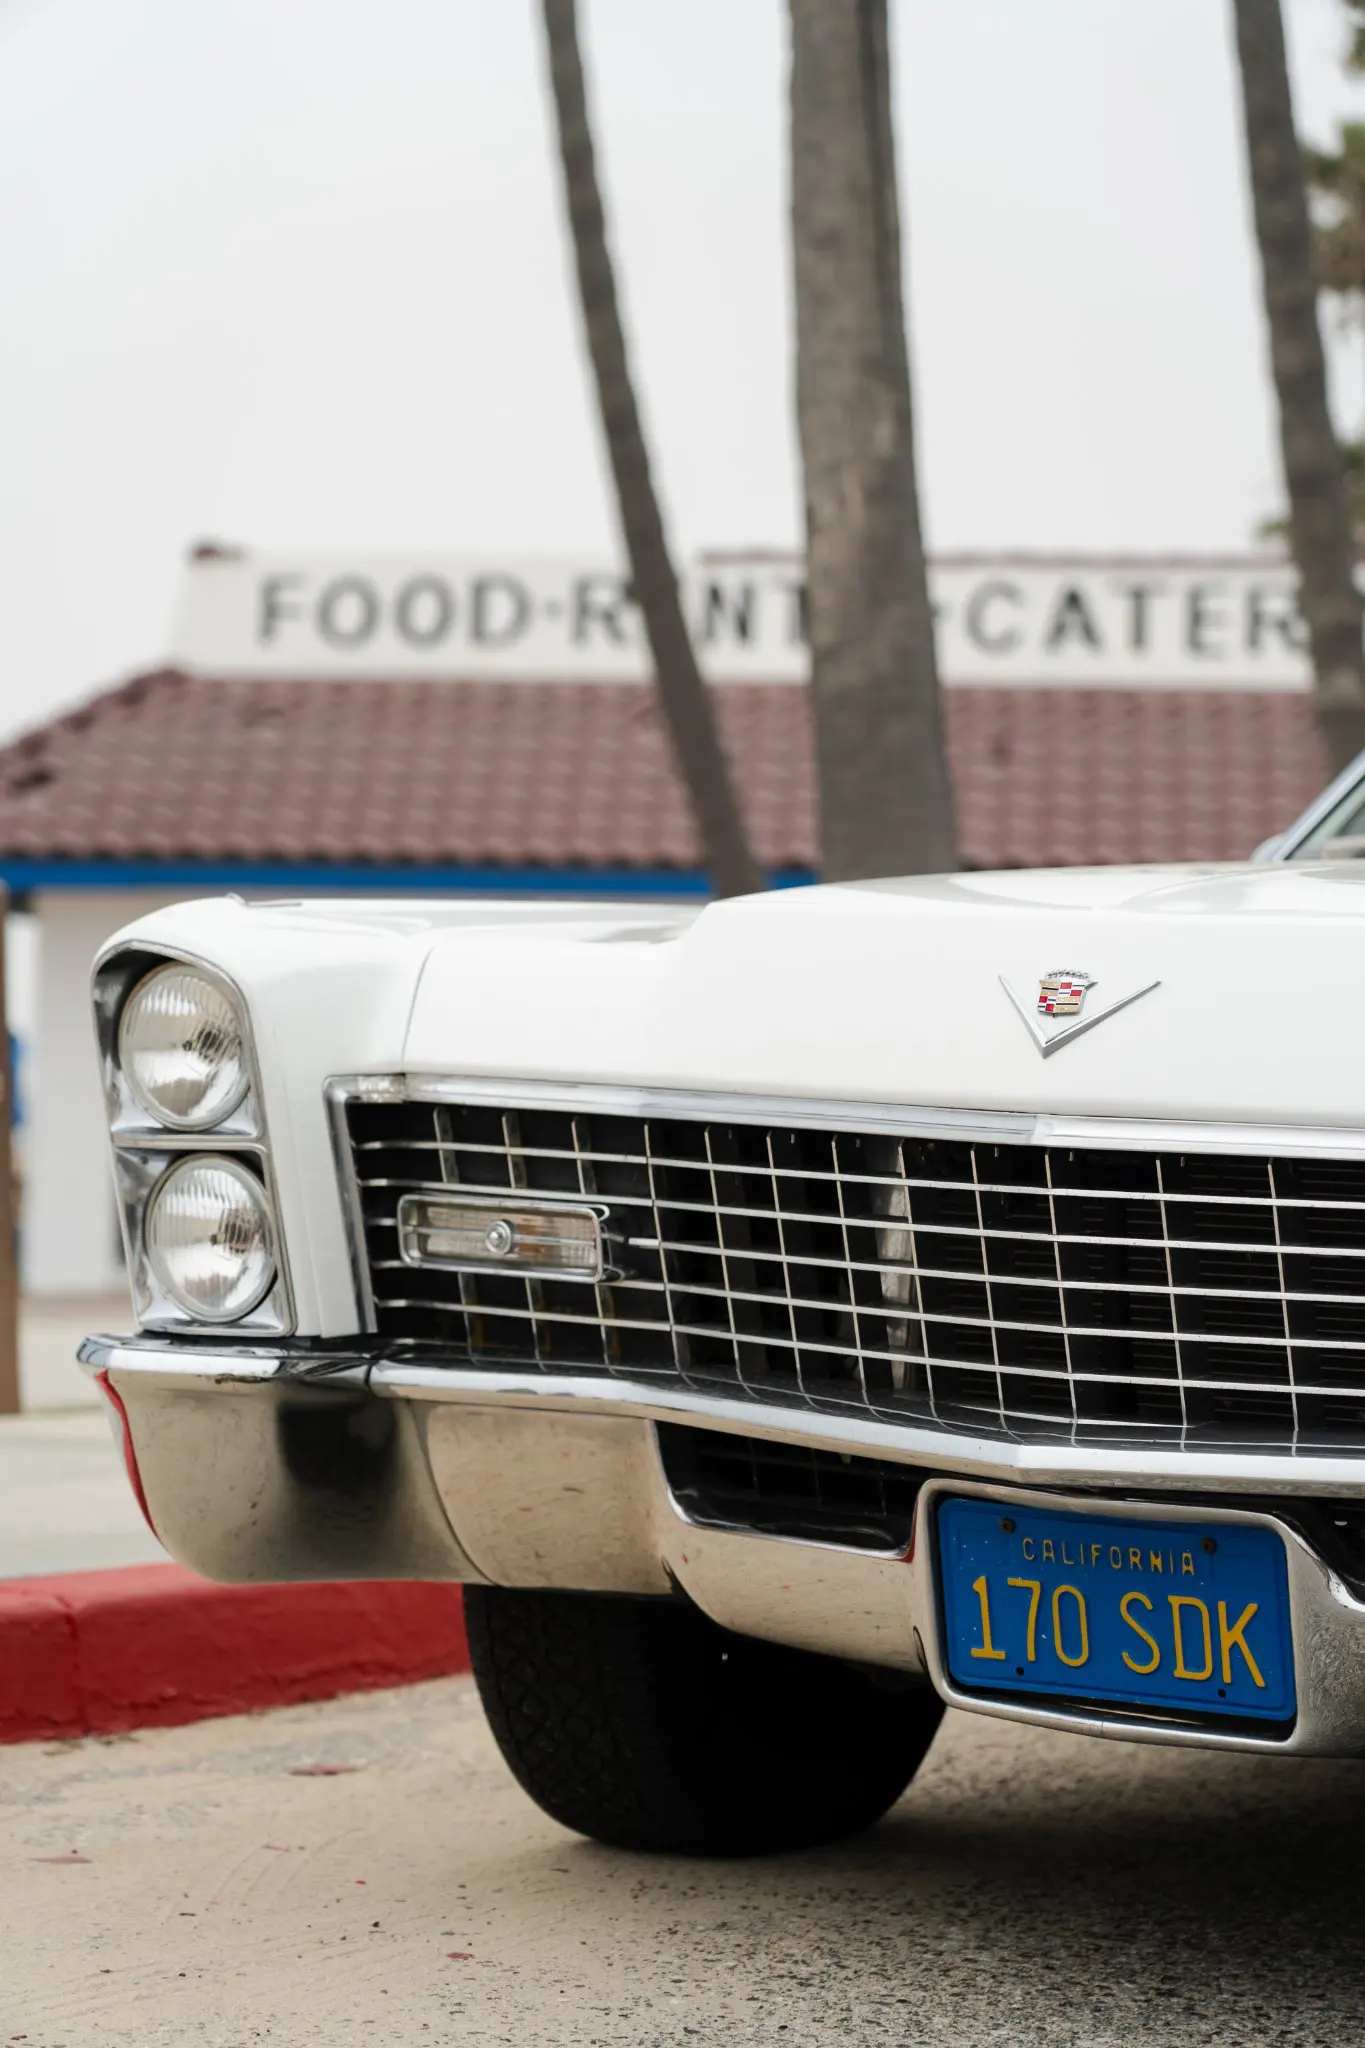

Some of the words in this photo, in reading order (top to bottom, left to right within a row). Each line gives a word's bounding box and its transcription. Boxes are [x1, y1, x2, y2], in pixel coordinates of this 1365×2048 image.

[259, 573, 533, 648] FOOD
[1022, 1537, 1196, 1577] CALIFORNIA
[970, 1575, 1089, 1668] 170
[1119, 1591, 1266, 1688] SDK
